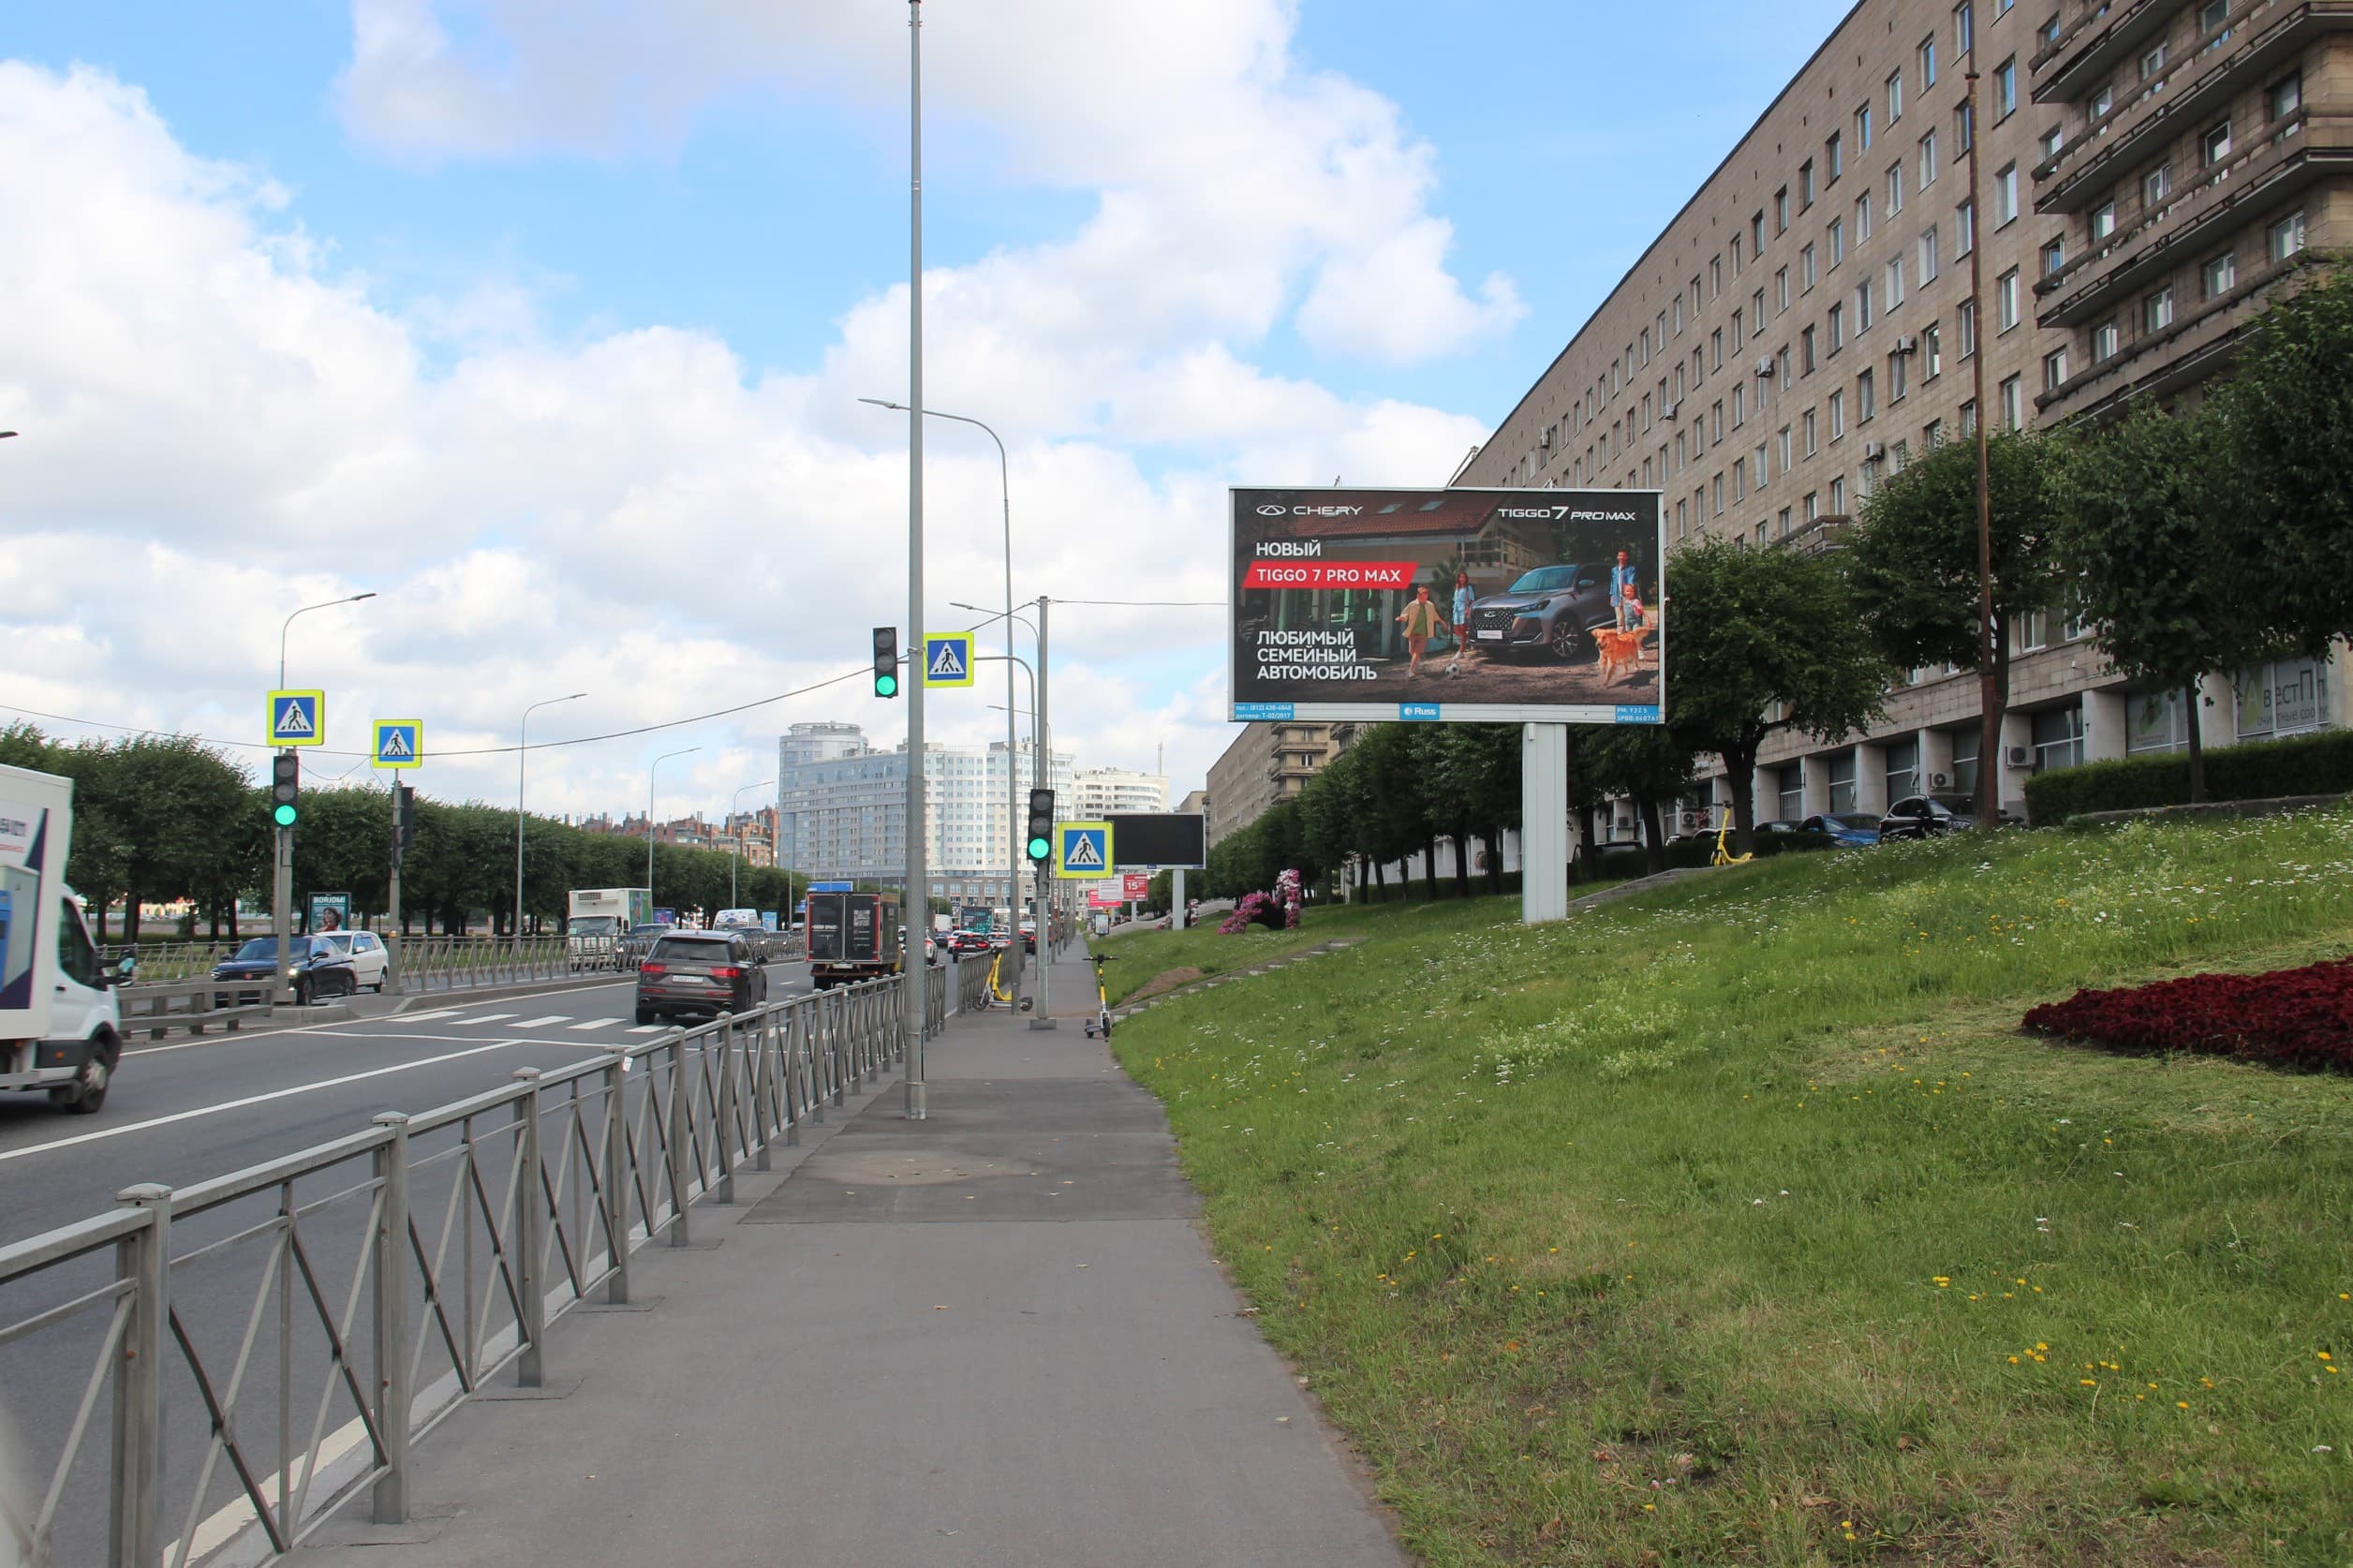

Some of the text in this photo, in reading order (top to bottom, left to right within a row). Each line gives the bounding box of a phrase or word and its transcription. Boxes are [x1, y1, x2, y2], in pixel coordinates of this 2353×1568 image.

[1293, 506, 1364, 516] CHERY
[1256, 539, 1322, 556] НОВЫЙ
[1257, 569, 1401, 582] TIGGO 7 PRO MAX
[1257, 628, 1354, 645] ЛЮБИМЫЙ
[1257, 645, 1356, 663] СЕМЕЙНЫЙ
[1257, 666, 1378, 680] АВТОМОБИЛЬ
[1414, 706, 1437, 716] Russ
